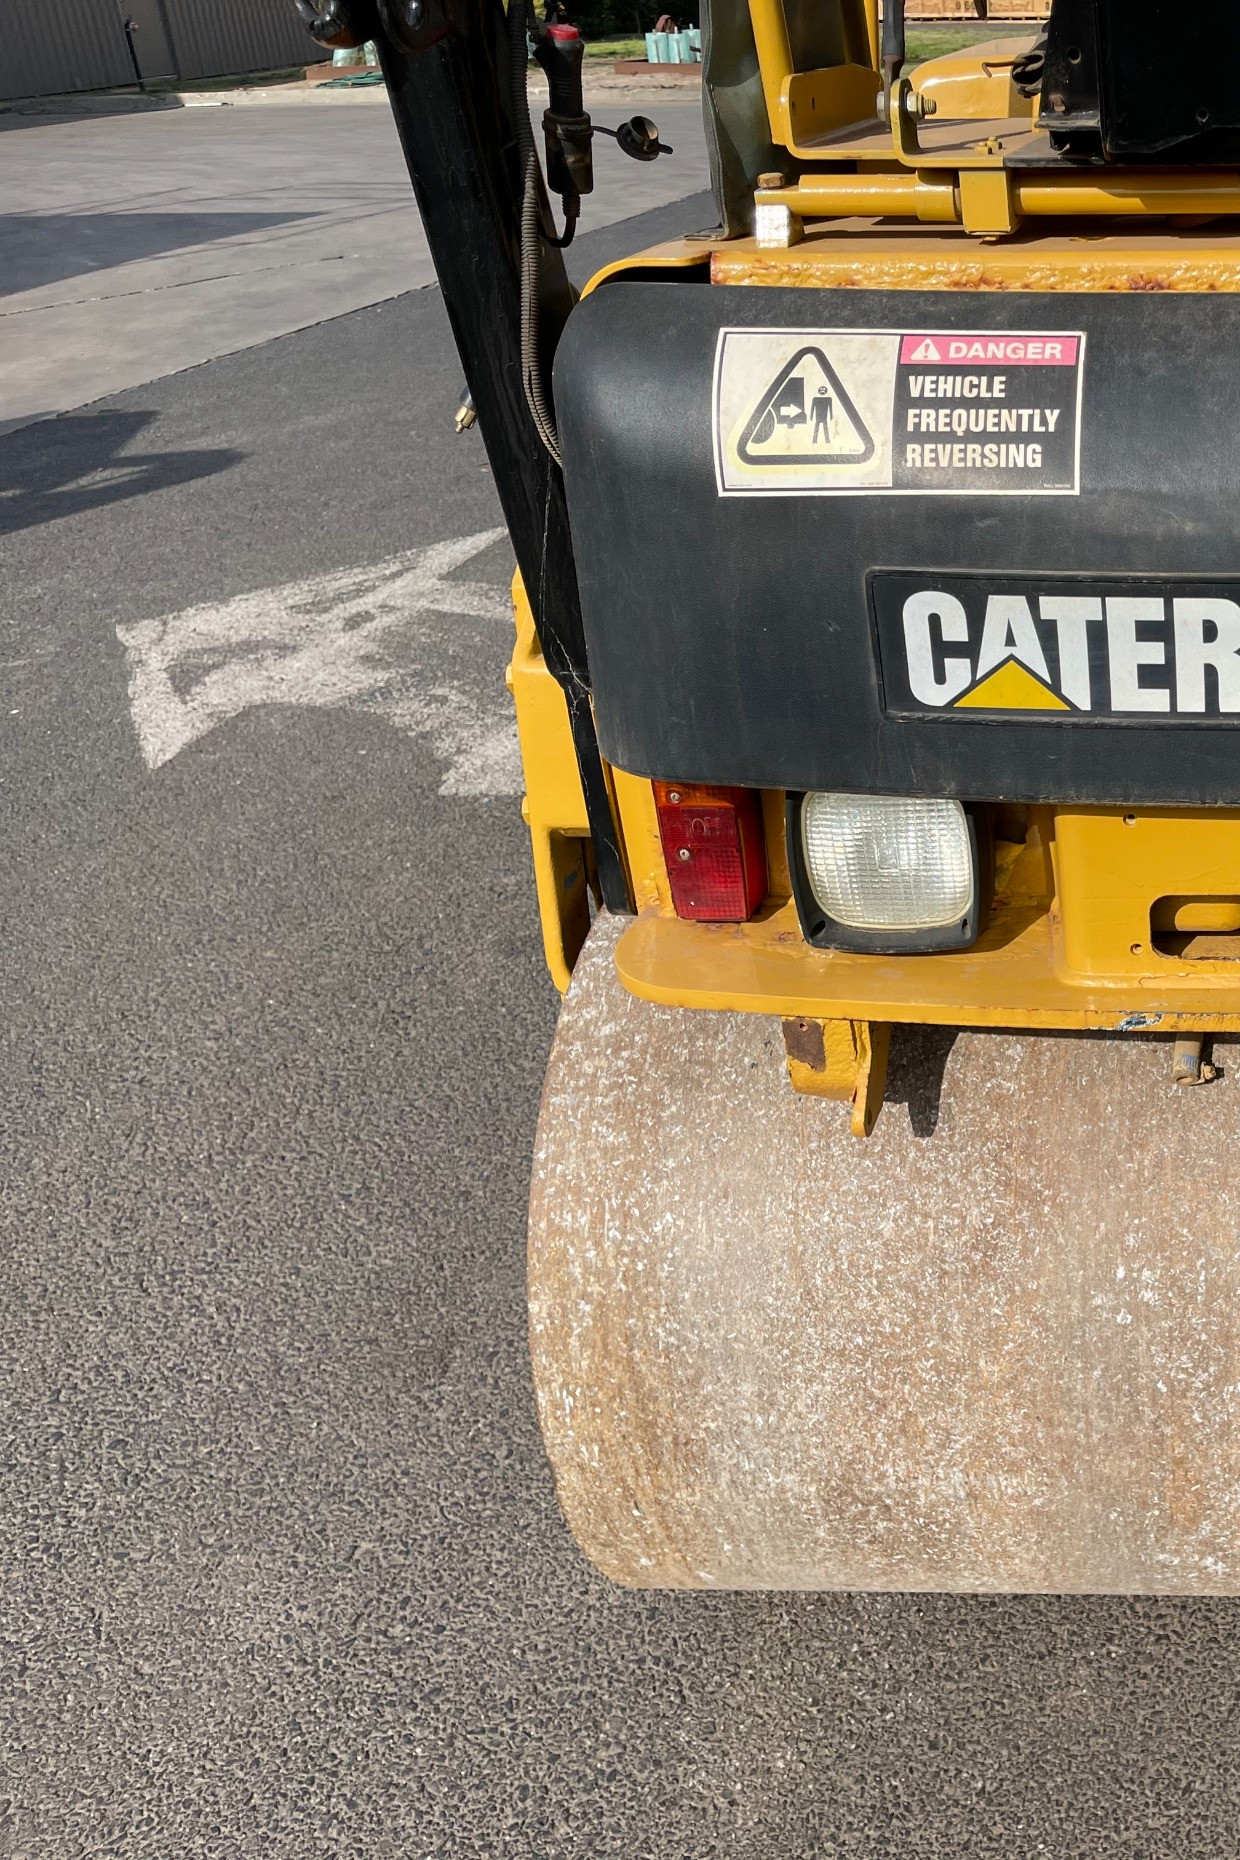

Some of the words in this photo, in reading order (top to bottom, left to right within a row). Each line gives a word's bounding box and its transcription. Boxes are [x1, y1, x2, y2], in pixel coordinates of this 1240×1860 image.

[948, 341, 1063, 360] DANGER
[908, 375, 1007, 398] VEHICLE
[906, 408, 1061, 437] FREQUENTLY
[906, 443, 1042, 468] REVERSING
